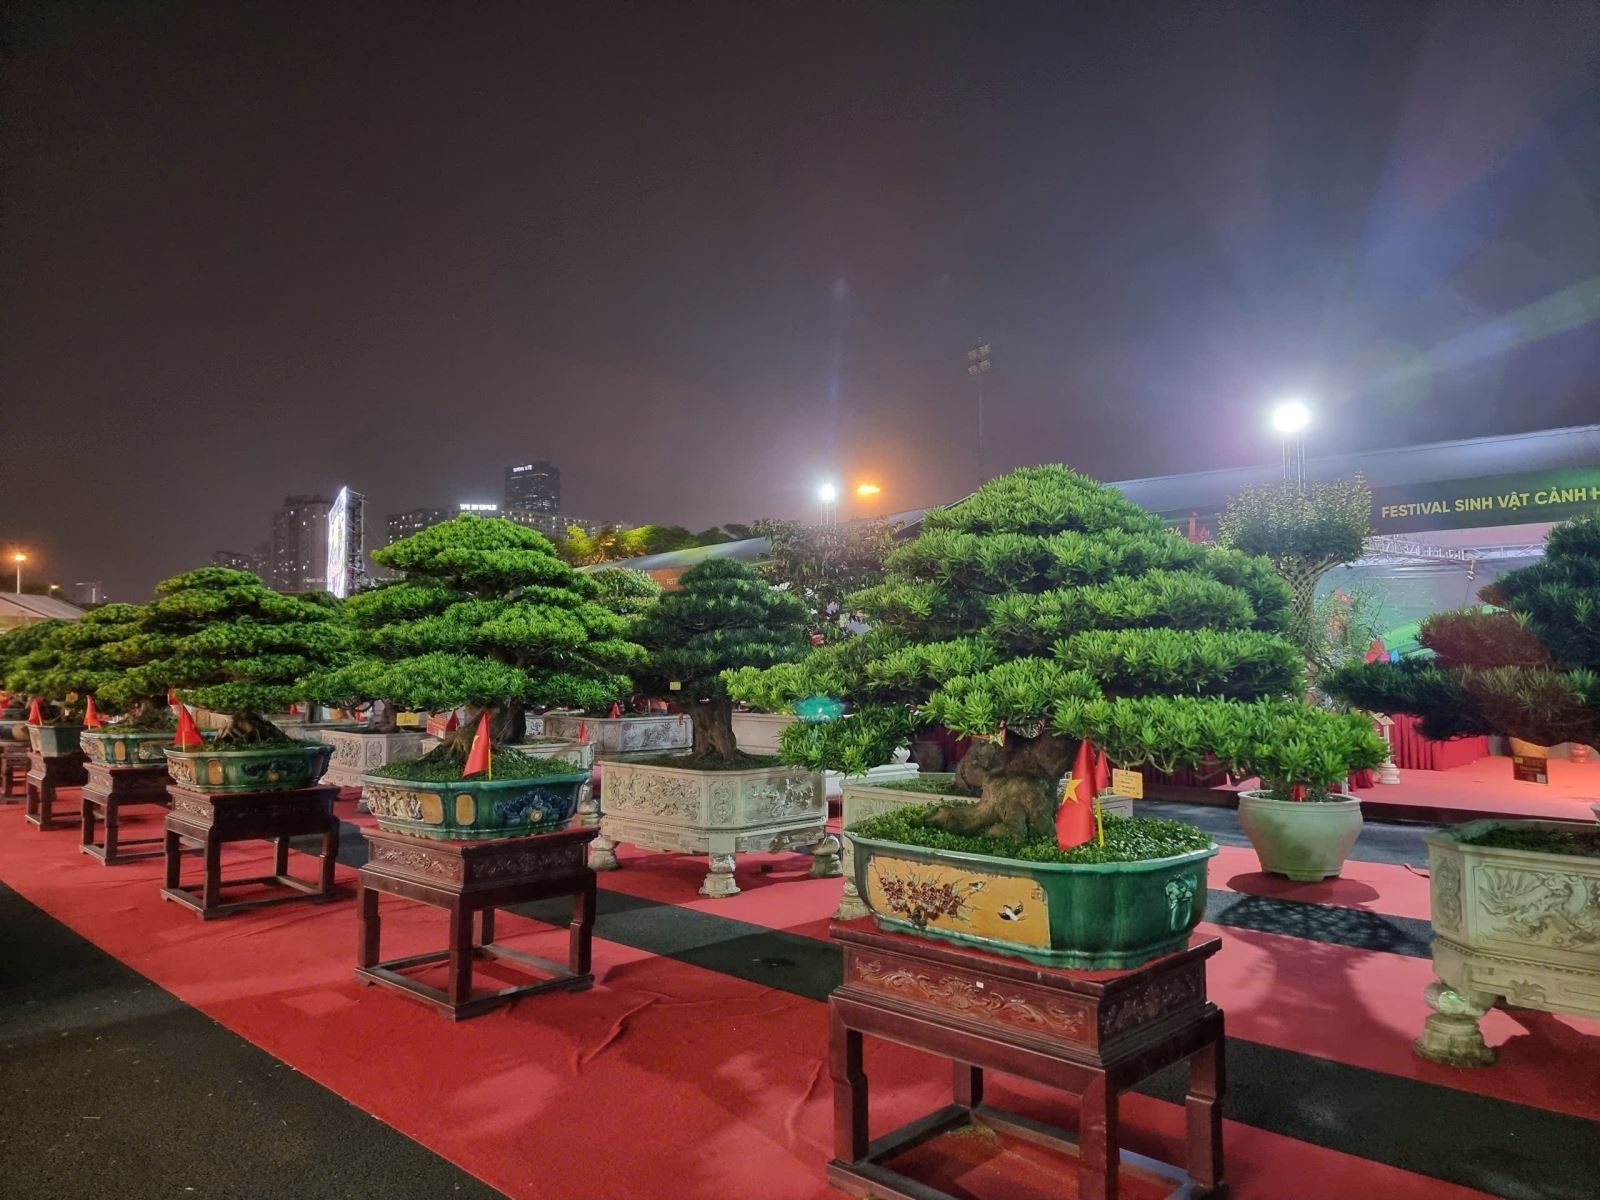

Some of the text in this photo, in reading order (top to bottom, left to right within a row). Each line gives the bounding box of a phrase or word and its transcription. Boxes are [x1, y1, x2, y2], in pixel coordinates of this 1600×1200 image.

[1381, 501, 1451, 518] FESTIVAL
[1455, 497, 1493, 512] SINH
[1497, 491, 1530, 511] VẬT
[1534, 486, 1587, 505] CẢNH
